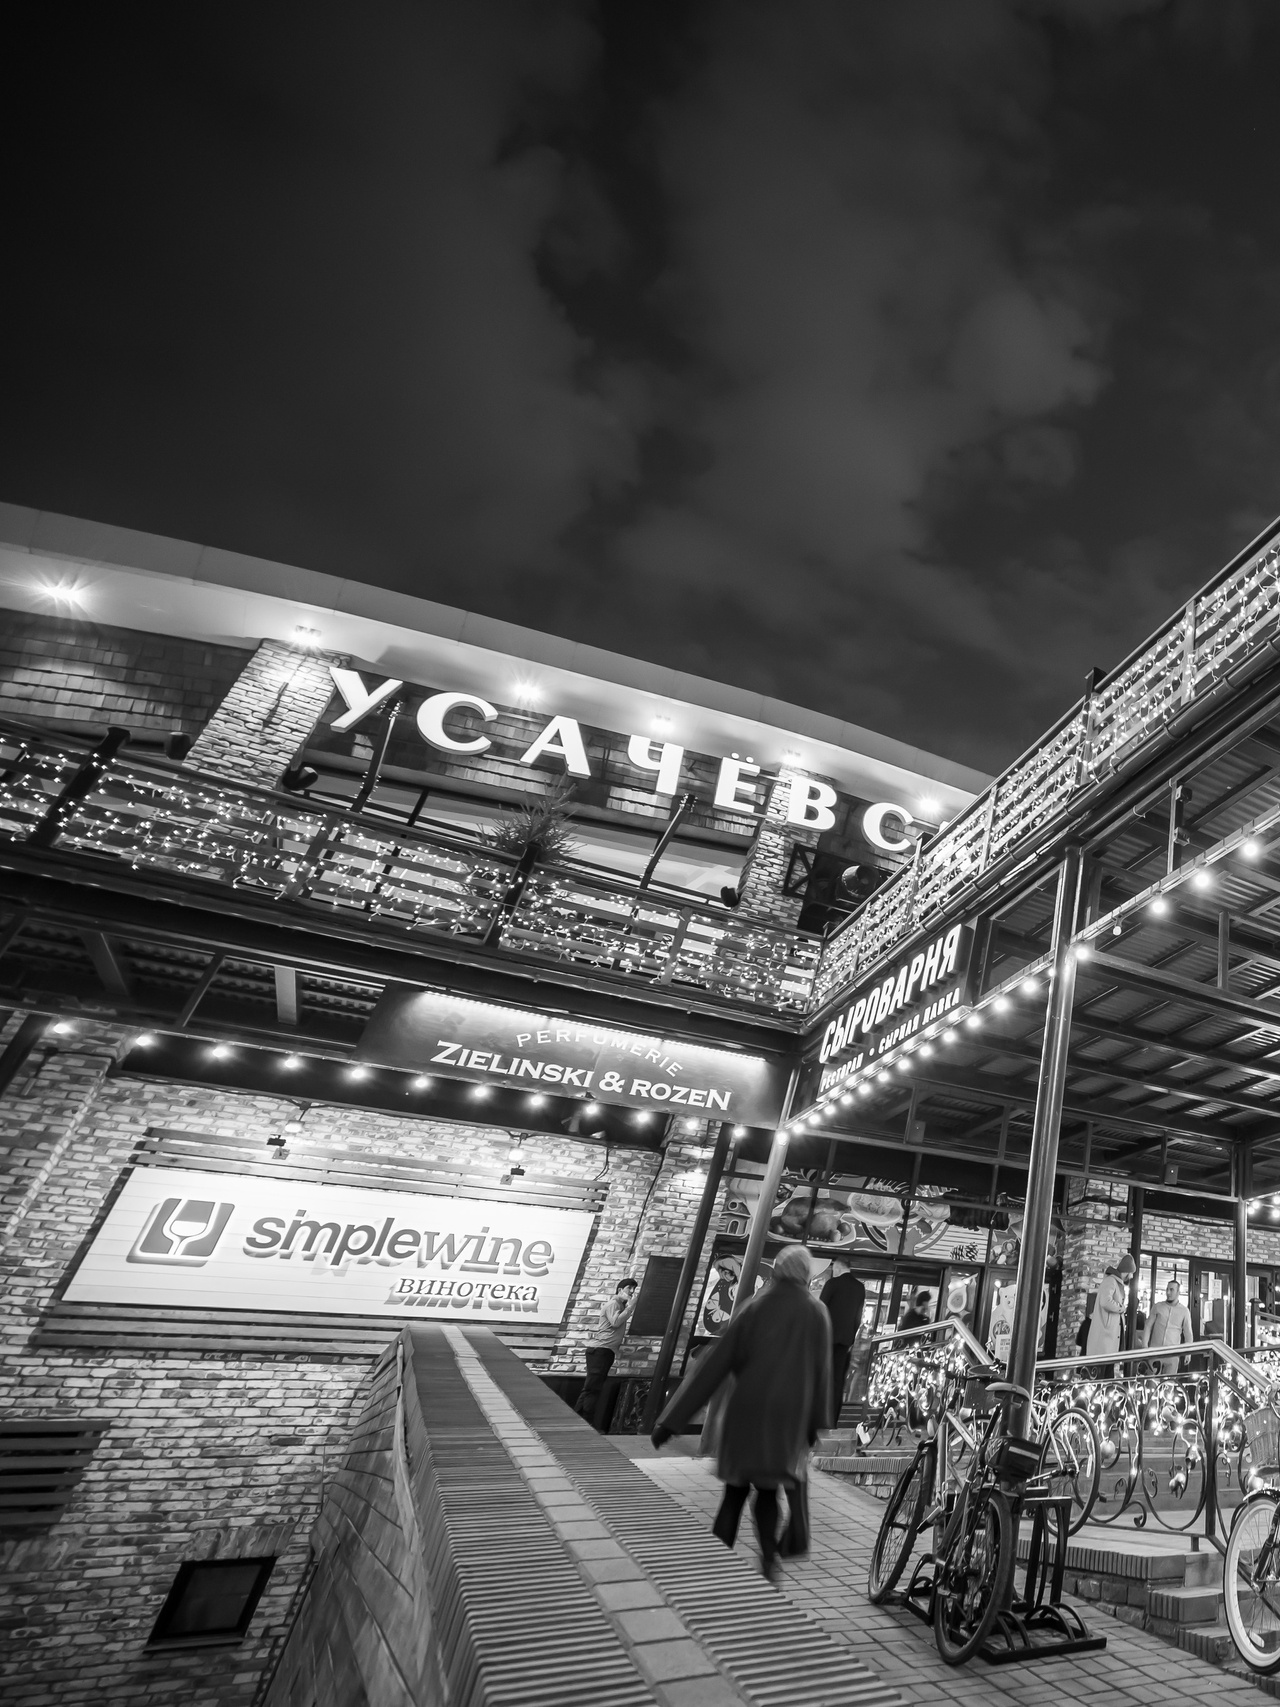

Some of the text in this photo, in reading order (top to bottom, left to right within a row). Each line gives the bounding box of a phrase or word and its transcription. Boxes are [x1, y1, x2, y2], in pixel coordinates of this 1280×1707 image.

[329, 667, 949, 852] УСАЧЁВС
[819, 923, 962, 1064] СЫРОВАРНЯ
[430, 1039, 732, 1111] ZIELINSKI & ROZEN
[515, 1028, 684, 1078] PERFUMERIE
[820, 987, 960, 1093] РЕСТОРАН СЫРНАЯ ЛАВКА
[245, 1209, 553, 1271] simplewine
[397, 1276, 539, 1303] винотека
